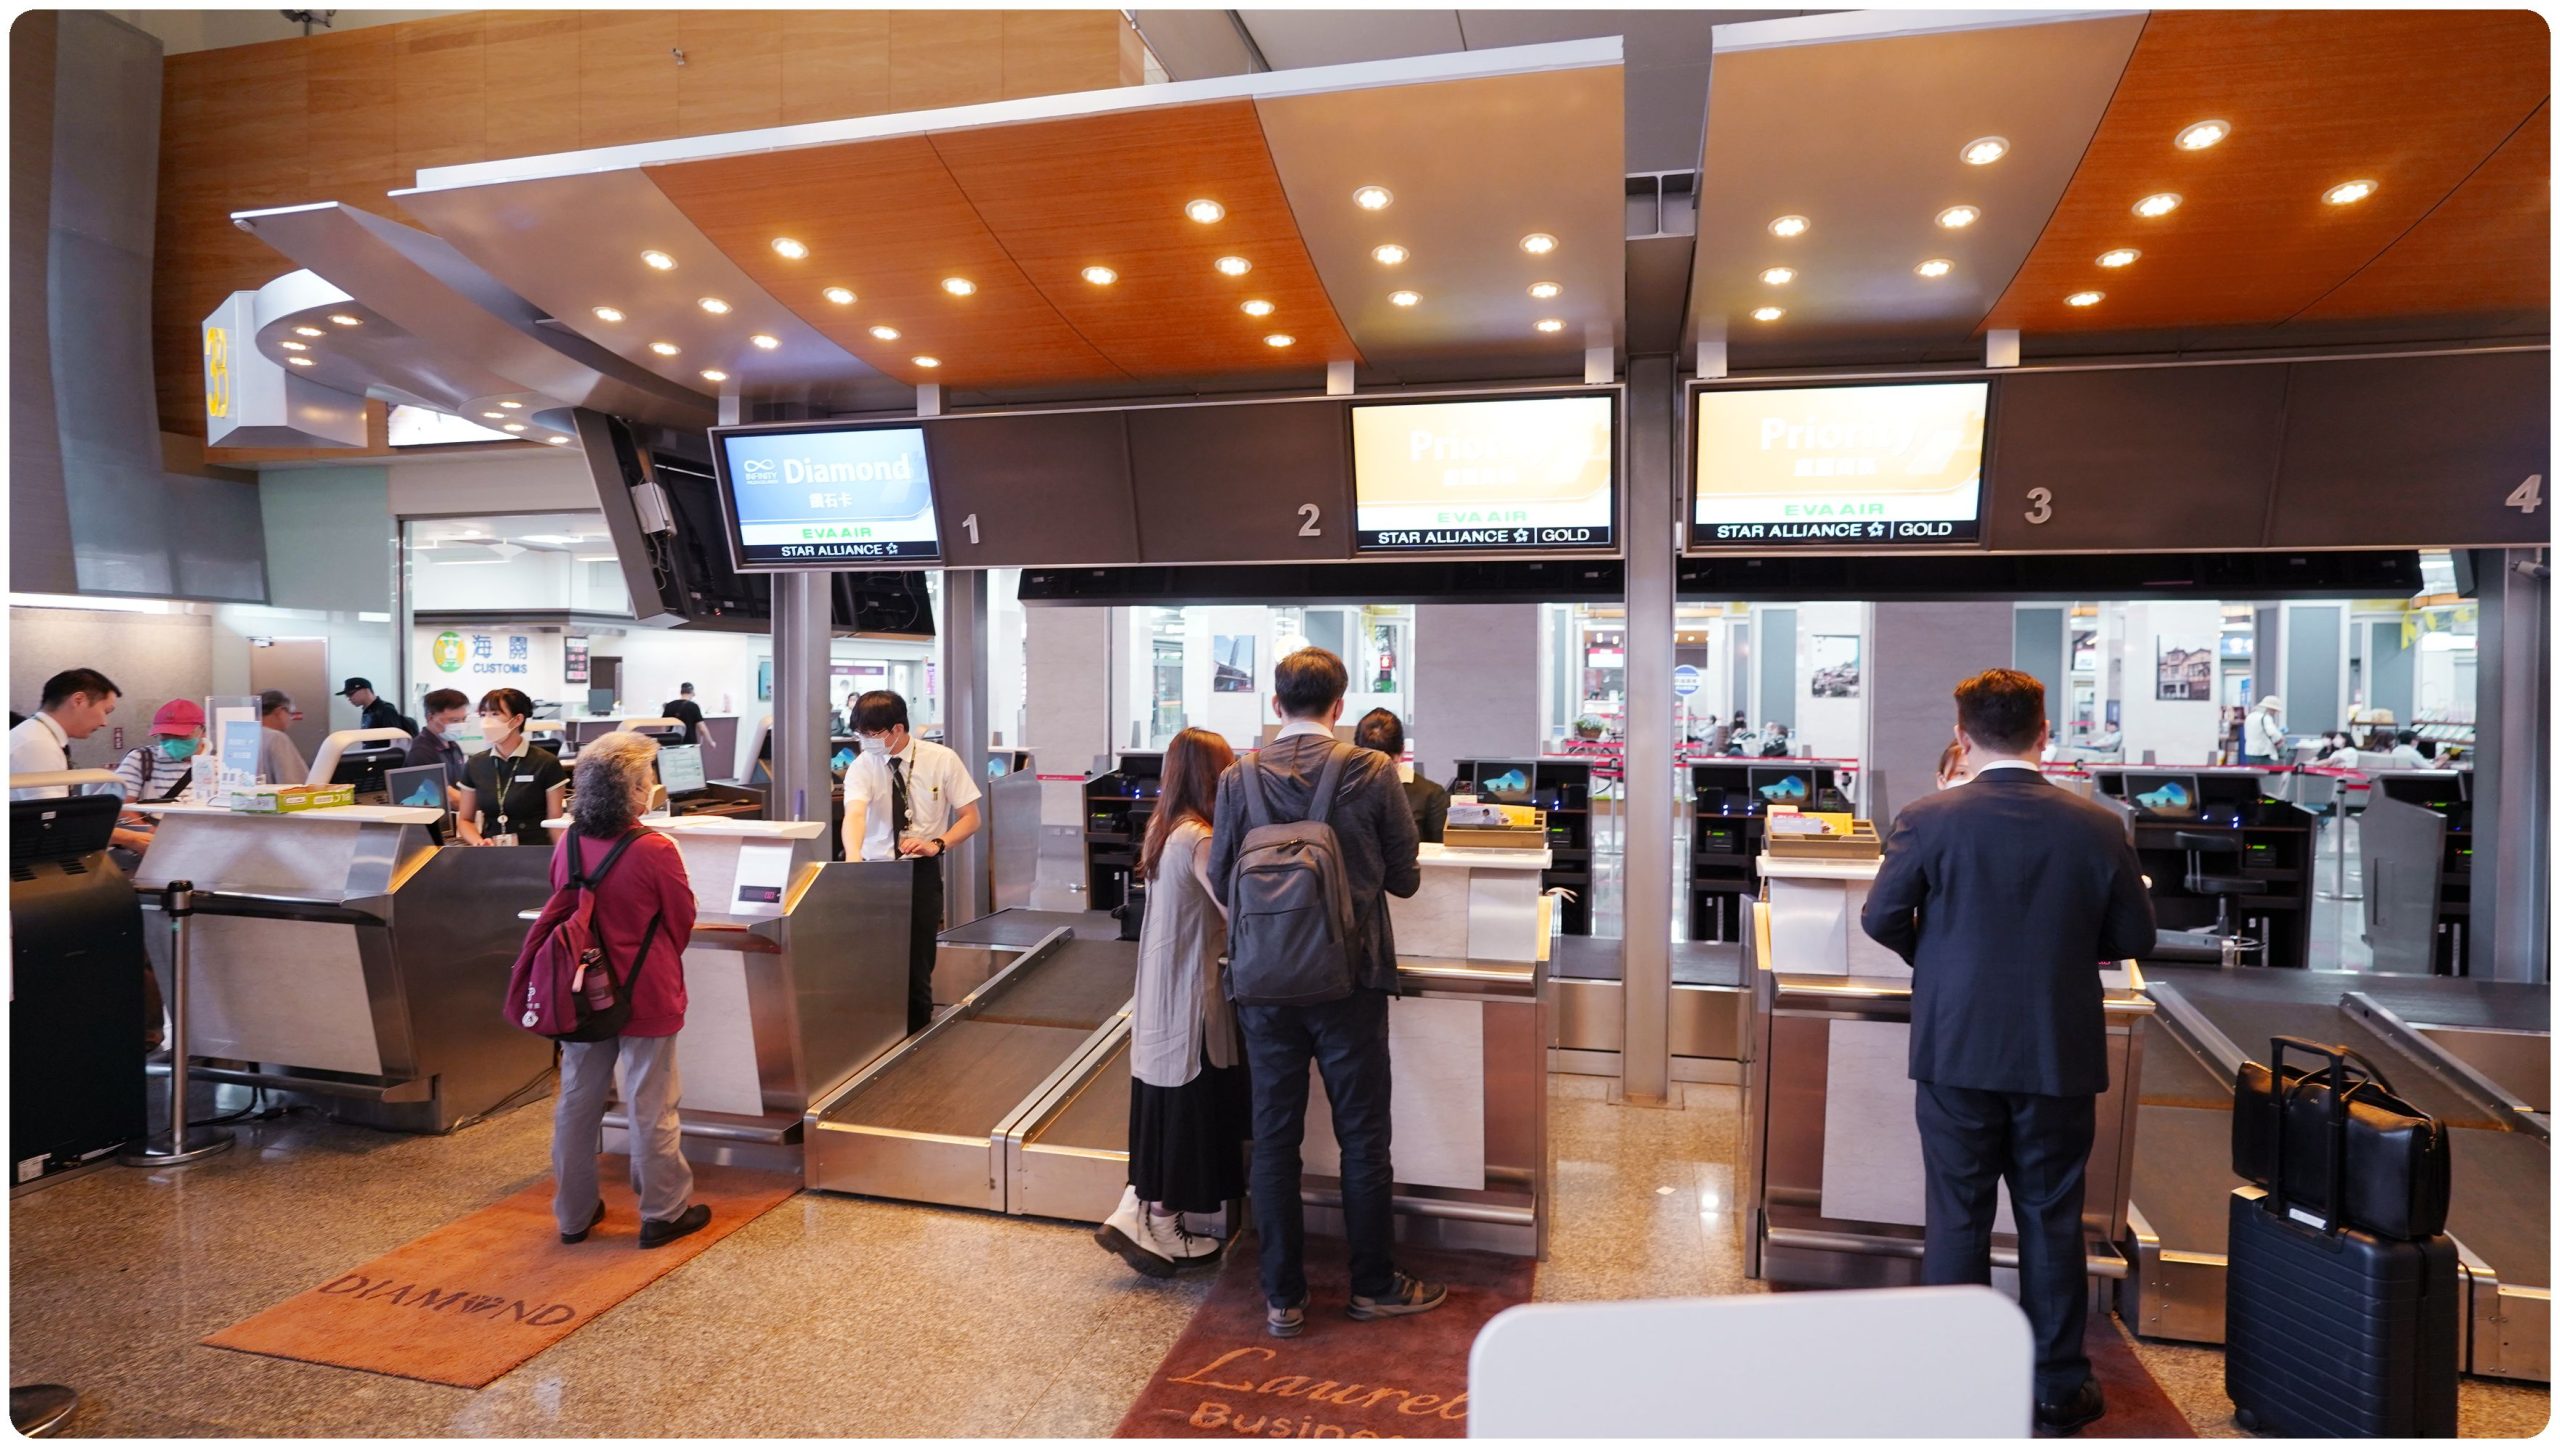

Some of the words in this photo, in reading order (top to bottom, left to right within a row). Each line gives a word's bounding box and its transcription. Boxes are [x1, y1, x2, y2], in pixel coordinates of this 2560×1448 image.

[783, 452, 912, 485] Diamond
[2025, 487, 2052, 525] 3
[2505, 474, 2542, 513] 4
[962, 513, 980, 544] 1
[1297, 503, 1321, 537] 2
[1717, 525, 1764, 538] STAR
[1769, 524, 1862, 538] ALLIANCE
[1898, 523, 1953, 536] GOLD
[781, 545, 815, 557] STAR
[818, 544, 883, 556] ALLIANCE
[1378, 531, 1421, 544] STAR
[1425, 530, 1509, 544] ALLIANCE
[1541, 529, 1590, 542] GOLD
[473, 663, 528, 674] CUSTOMS
[1189, 1401, 1405, 1439] Busin
